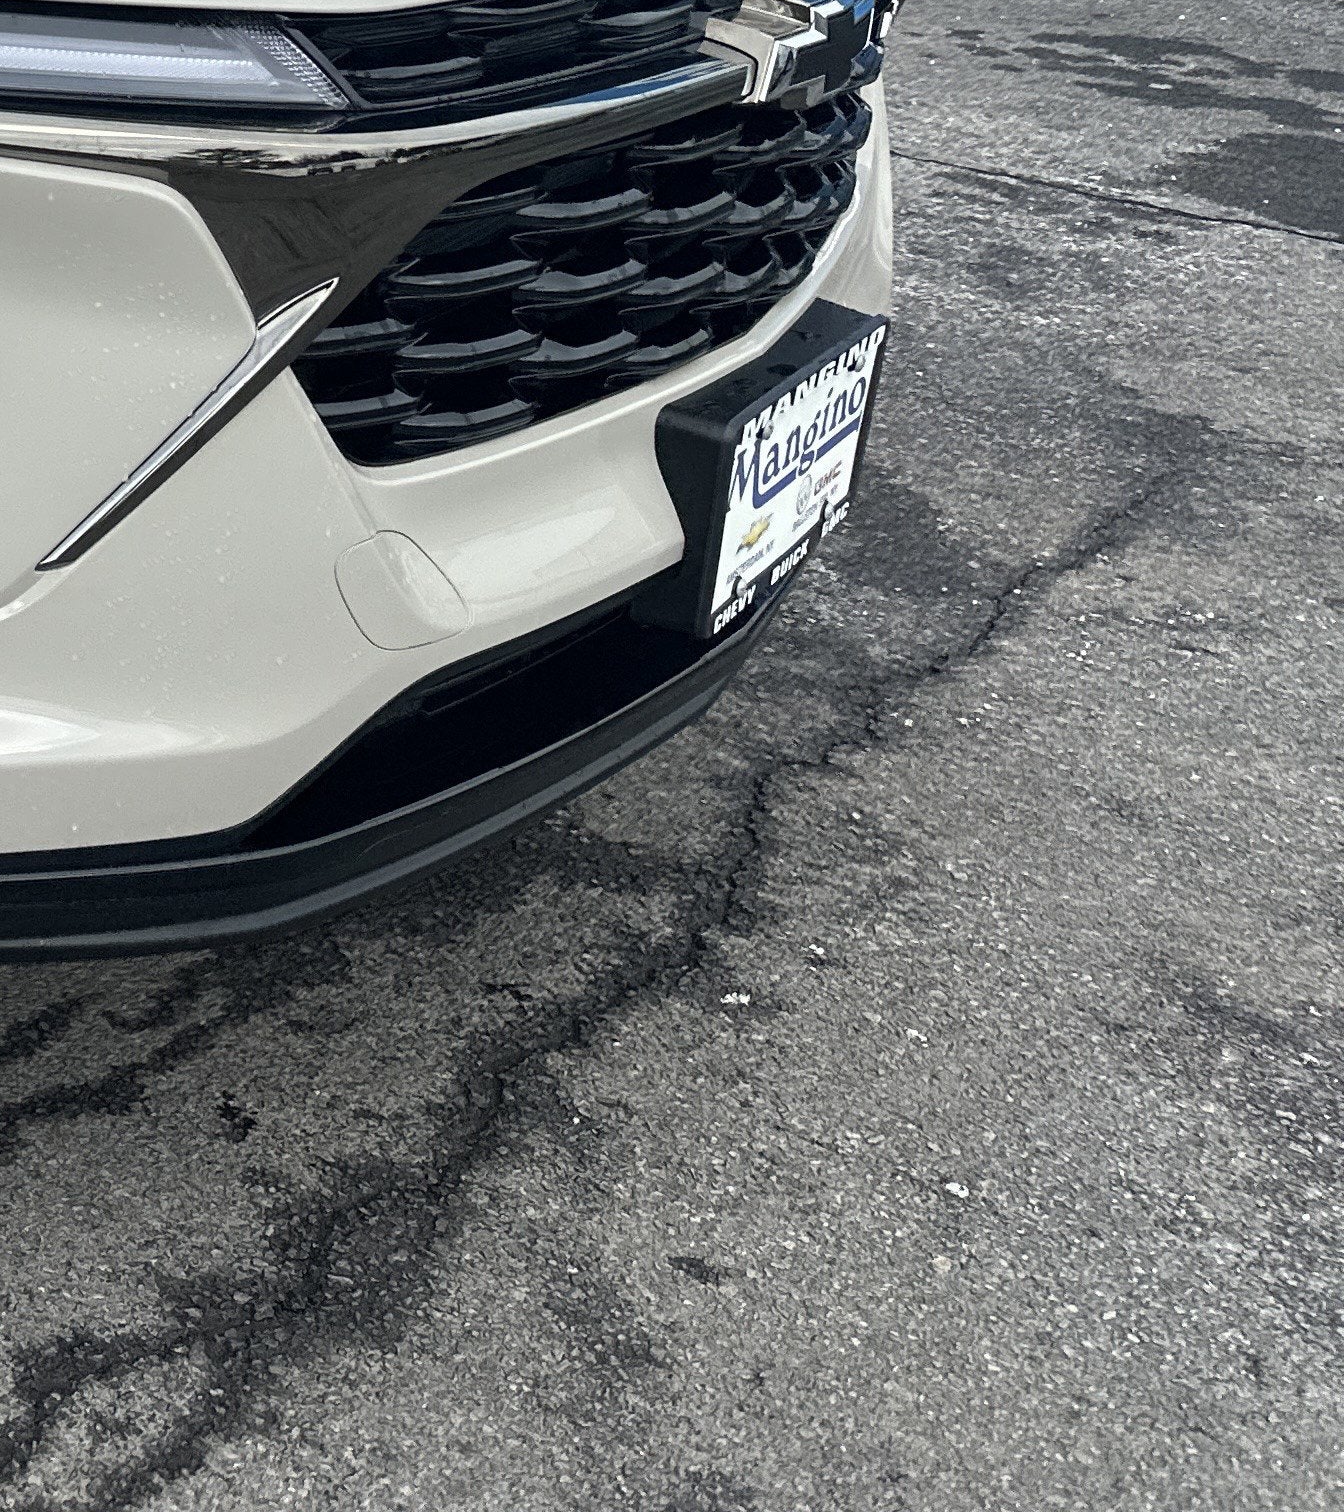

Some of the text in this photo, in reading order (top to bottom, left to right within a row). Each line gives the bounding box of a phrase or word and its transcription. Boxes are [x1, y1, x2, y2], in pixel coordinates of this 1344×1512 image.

[743, 325, 885, 439] MANGINO
[729, 376, 867, 509] Mangino
[770, 538, 810, 586] BUICK
[713, 584, 756, 635] CHEVY
